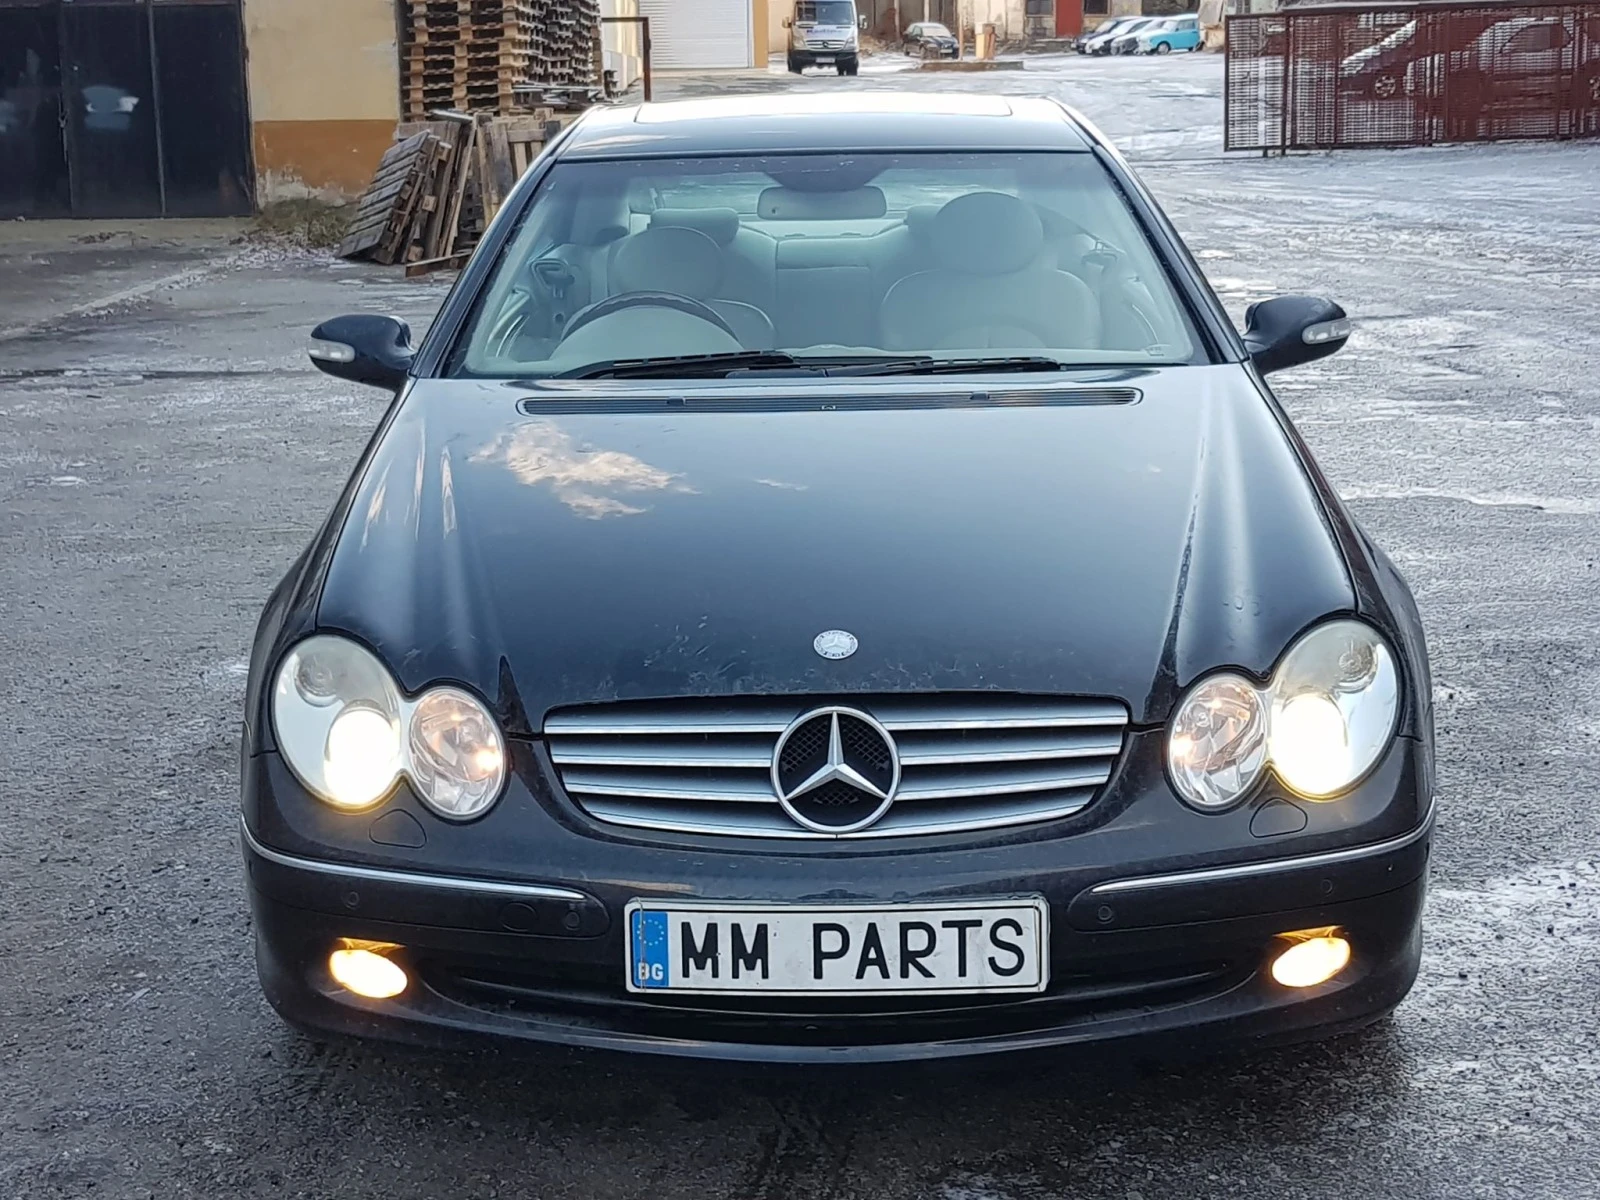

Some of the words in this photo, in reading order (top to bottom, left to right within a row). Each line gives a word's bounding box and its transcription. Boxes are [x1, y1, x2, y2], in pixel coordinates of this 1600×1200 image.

[680, 921, 769, 979] MM
[812, 918, 1025, 980] PARTS
[638, 961, 664, 981] BG
